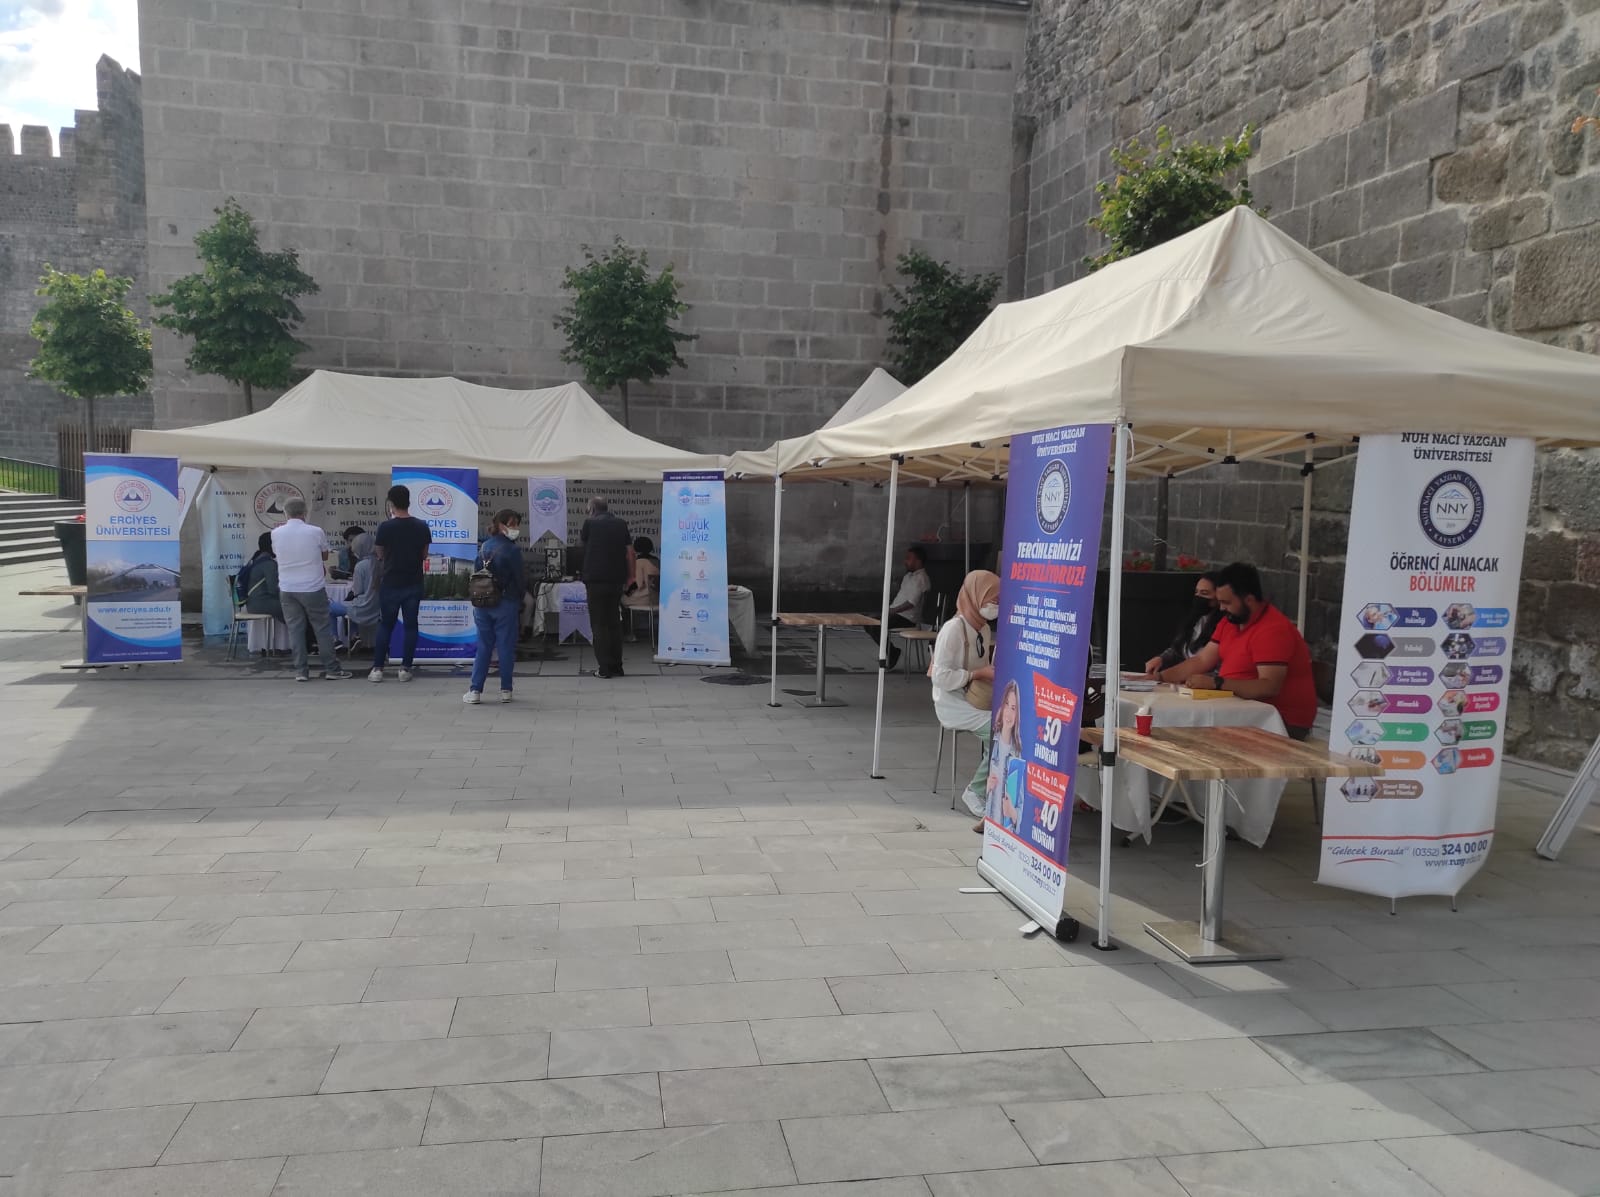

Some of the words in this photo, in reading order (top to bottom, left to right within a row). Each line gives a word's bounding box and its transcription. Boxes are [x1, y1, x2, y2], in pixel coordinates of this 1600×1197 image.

[1032, 434, 1045, 445] NUH
[1045, 430, 1060, 442] NACİ
[1061, 427, 1086, 440] YAZGAN
[1401, 432, 1429, 444] NUH
[1432, 433, 1460, 446] NACİ
[1463, 435, 1507, 448] YAZGAN
[1037, 440, 1077, 457] ÜNİVERSİTESİ
[1414, 446, 1493, 463] ÜNİVERSİTESİ
[1436, 502, 1469, 515] NNY
[109, 514, 158, 525] ERCİYES
[426, 518, 457, 528] CİYES
[95, 525, 171, 536] ÜNİVERSİTESİ
[431, 530, 470, 539] RSİTESİ
[1017, 538, 1083, 561] TERCİHLERİNİZİ
[1390, 552, 1440, 571] ÖĞRENCİ
[1442, 556, 1499, 572] ALINACAK
[1010, 560, 1087, 587] DESTEKLİYORUZ!
[1409, 571, 1476, 593] BÖLÜMLER
[1412, 846, 1440, 858] (0352)
[1441, 842, 1462, 856] 324
[1464, 842, 1476, 853] 00
[1477, 839, 1488, 850] 00
[1031, 855, 1042, 872] 324
[1042, 864, 1052, 881] 00
[1052, 871, 1062, 887] 00
